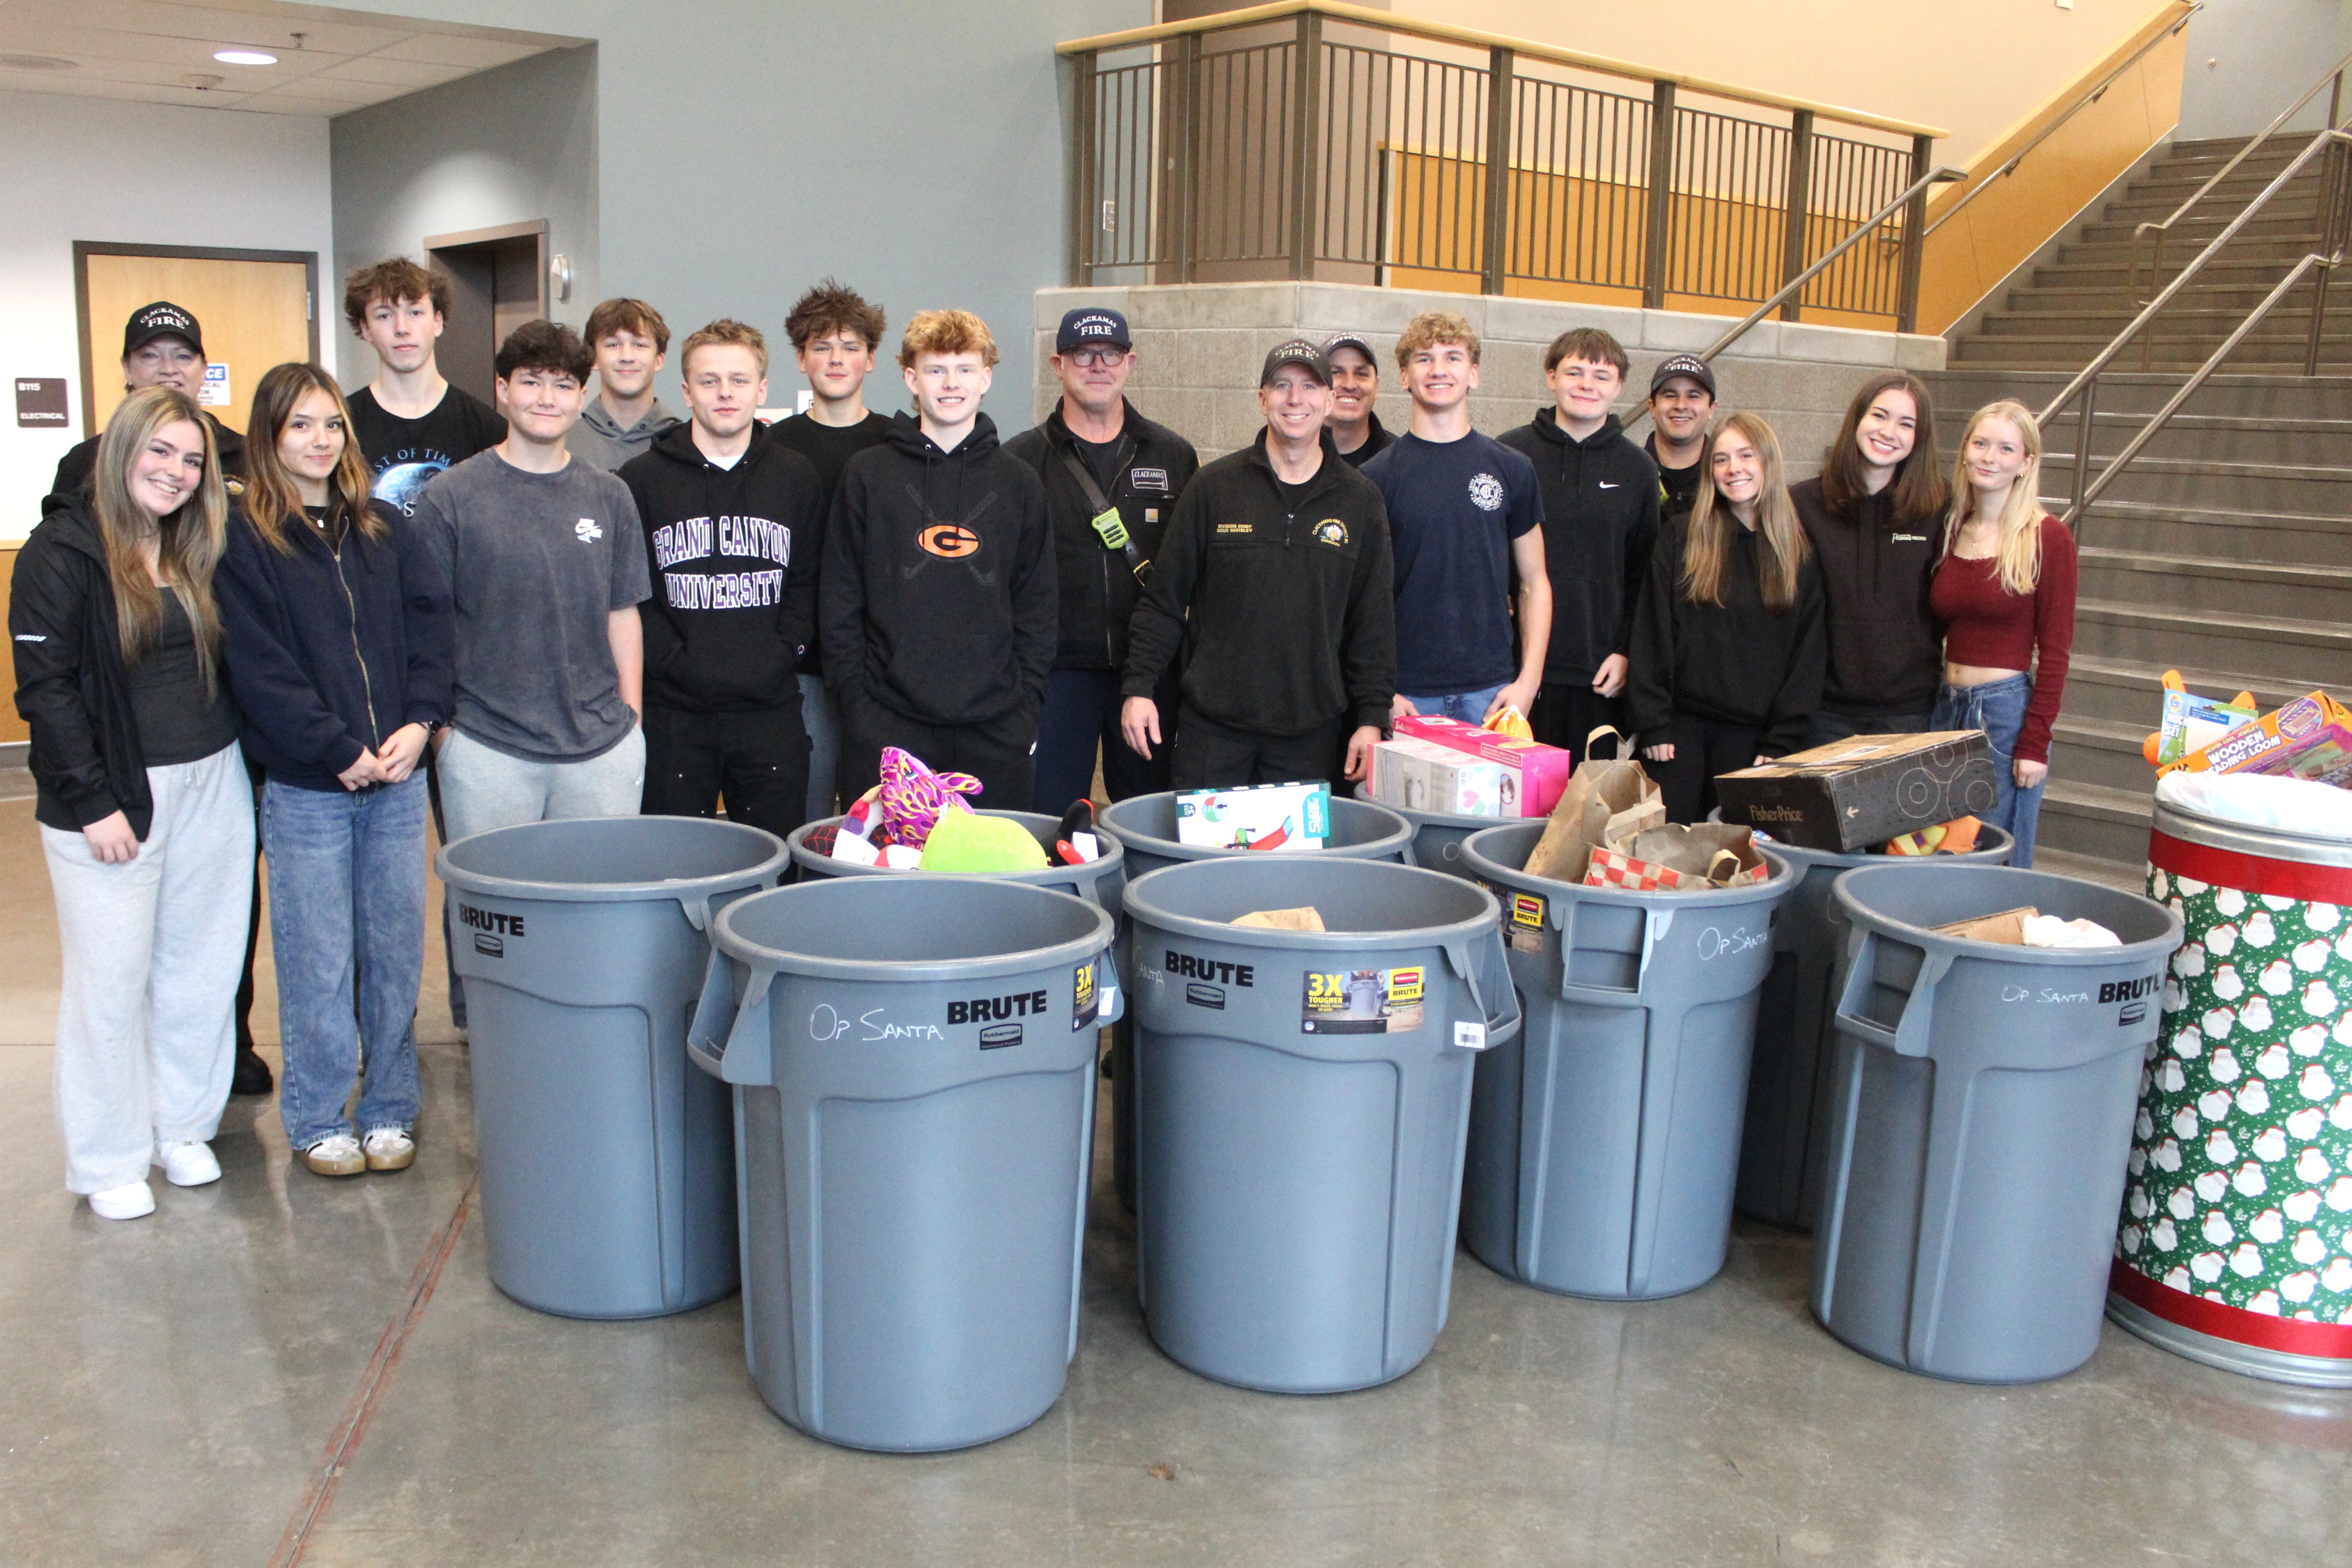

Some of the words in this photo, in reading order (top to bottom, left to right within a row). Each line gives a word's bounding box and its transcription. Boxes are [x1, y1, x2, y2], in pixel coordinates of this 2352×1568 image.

[140, 308, 189, 325] CLACKAMAS
[148, 316, 185, 329] FIRE
[1073, 315, 1117, 330] CLACKAMAS
[1081, 325, 1112, 336] FIRE
[1275, 342, 1320, 358] CLACKAMAS
[1280, 348, 1314, 360] FIRE
[1665, 358, 1703, 370] CLACKAMAS
[1671, 364, 1699, 374] FIRE
[18, 383, 41, 391] B115
[397, 448, 416, 460] OF
[425, 448, 451, 466] TIM
[653, 517, 714, 570] GRAND
[719, 516, 790, 568] CANYON
[918, 525, 979, 557] G
[665, 569, 783, 609] UNIVERSITY
[2164, 725, 2180, 738] SET
[2207, 730, 2265, 765] WOODEN
[2223, 736, 2236, 744] COOL
[2248, 735, 2281, 756] LOOM
[1189, 805, 1194, 815] 3+
[459, 903, 524, 937] BRUTE
[1516, 913, 1538, 923] BRUTE
[1166, 950, 1254, 988] BRUTE
[1076, 963, 1092, 992] 3X
[1308, 974, 1343, 997] 3X
[1190, 988, 1222, 999] Rubbermaid
[2098, 973, 2160, 1003] BRUTE
[948, 989, 1047, 1025] BRUTE
[984, 1029, 1020, 1038] Rubbermaid
